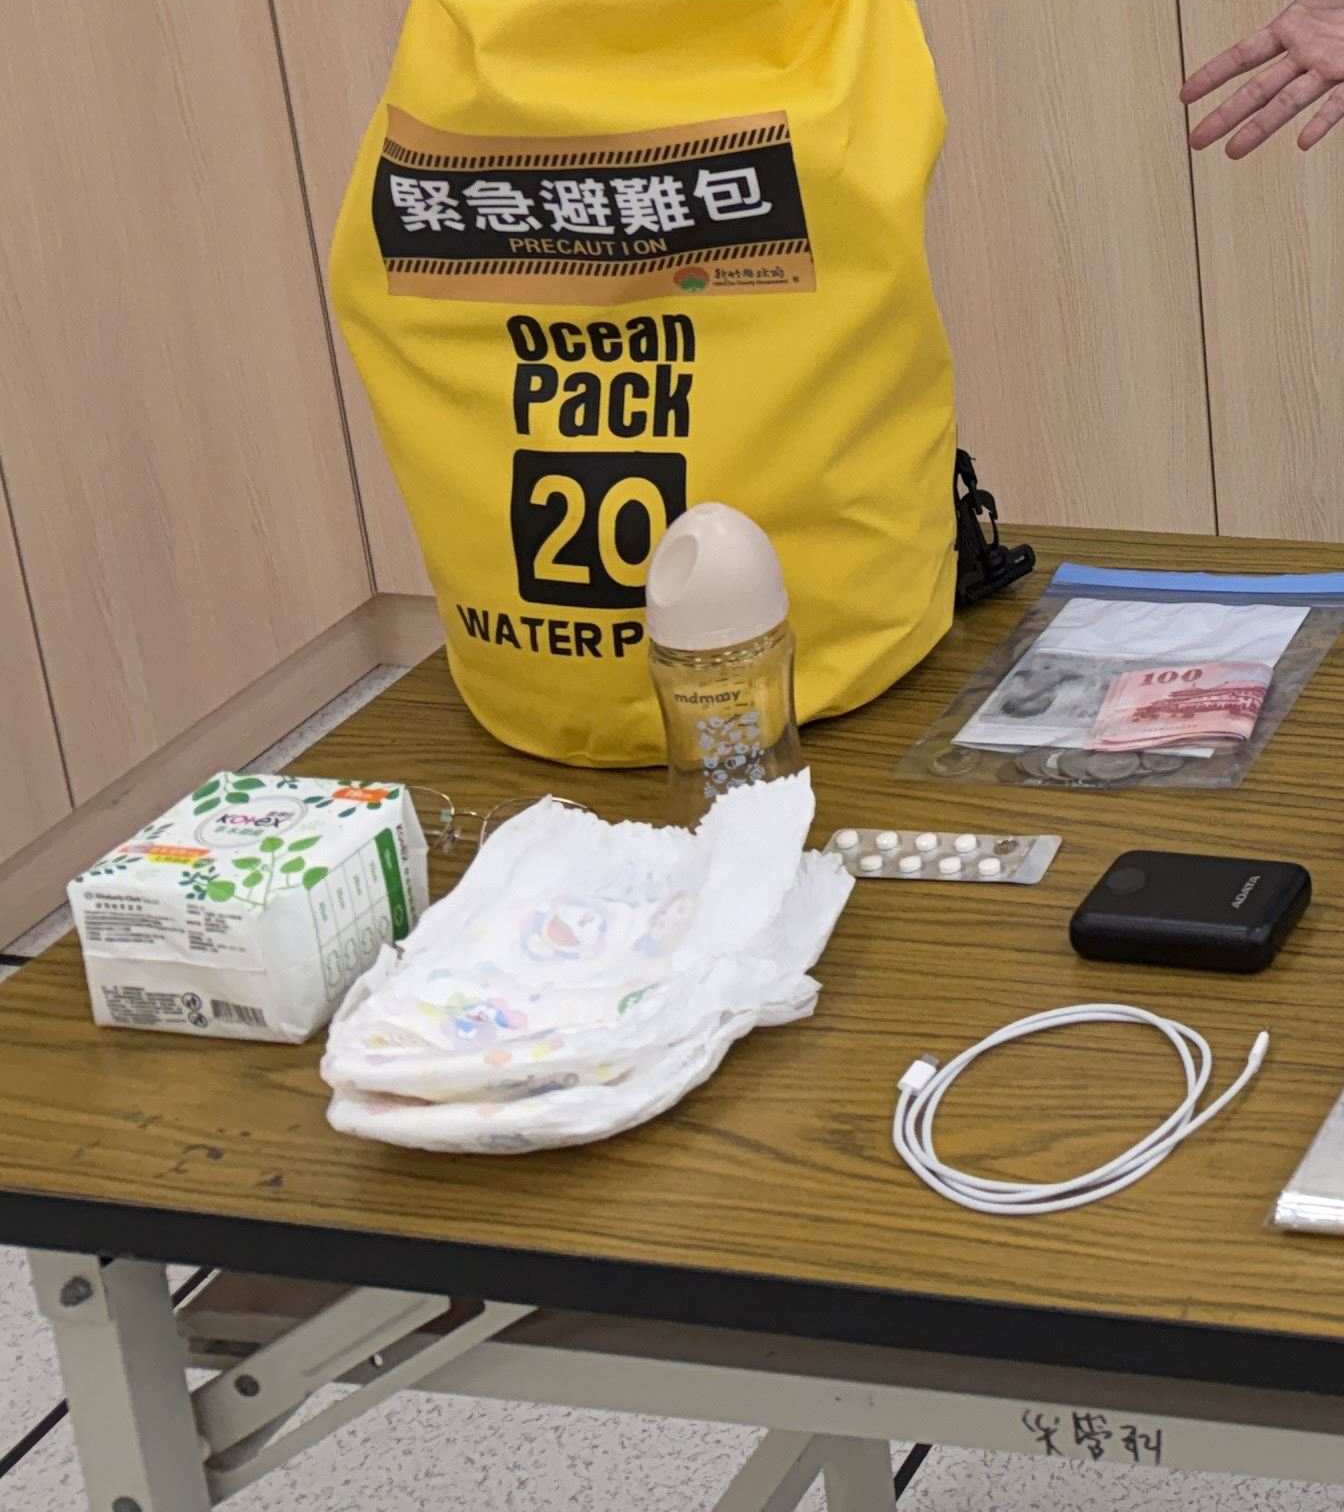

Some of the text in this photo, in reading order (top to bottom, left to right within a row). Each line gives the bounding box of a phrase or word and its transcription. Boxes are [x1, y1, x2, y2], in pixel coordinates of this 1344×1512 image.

[389, 167, 773, 237] 緊急避難包
[509, 237, 668, 258] PRECAUTION
[506, 313, 696, 363] Ocean
[512, 362, 694, 439] Pack
[529, 473, 667, 589] 20
[1140, 668, 1204, 687] 100
[1231, 875, 1261, 910] ADATA
